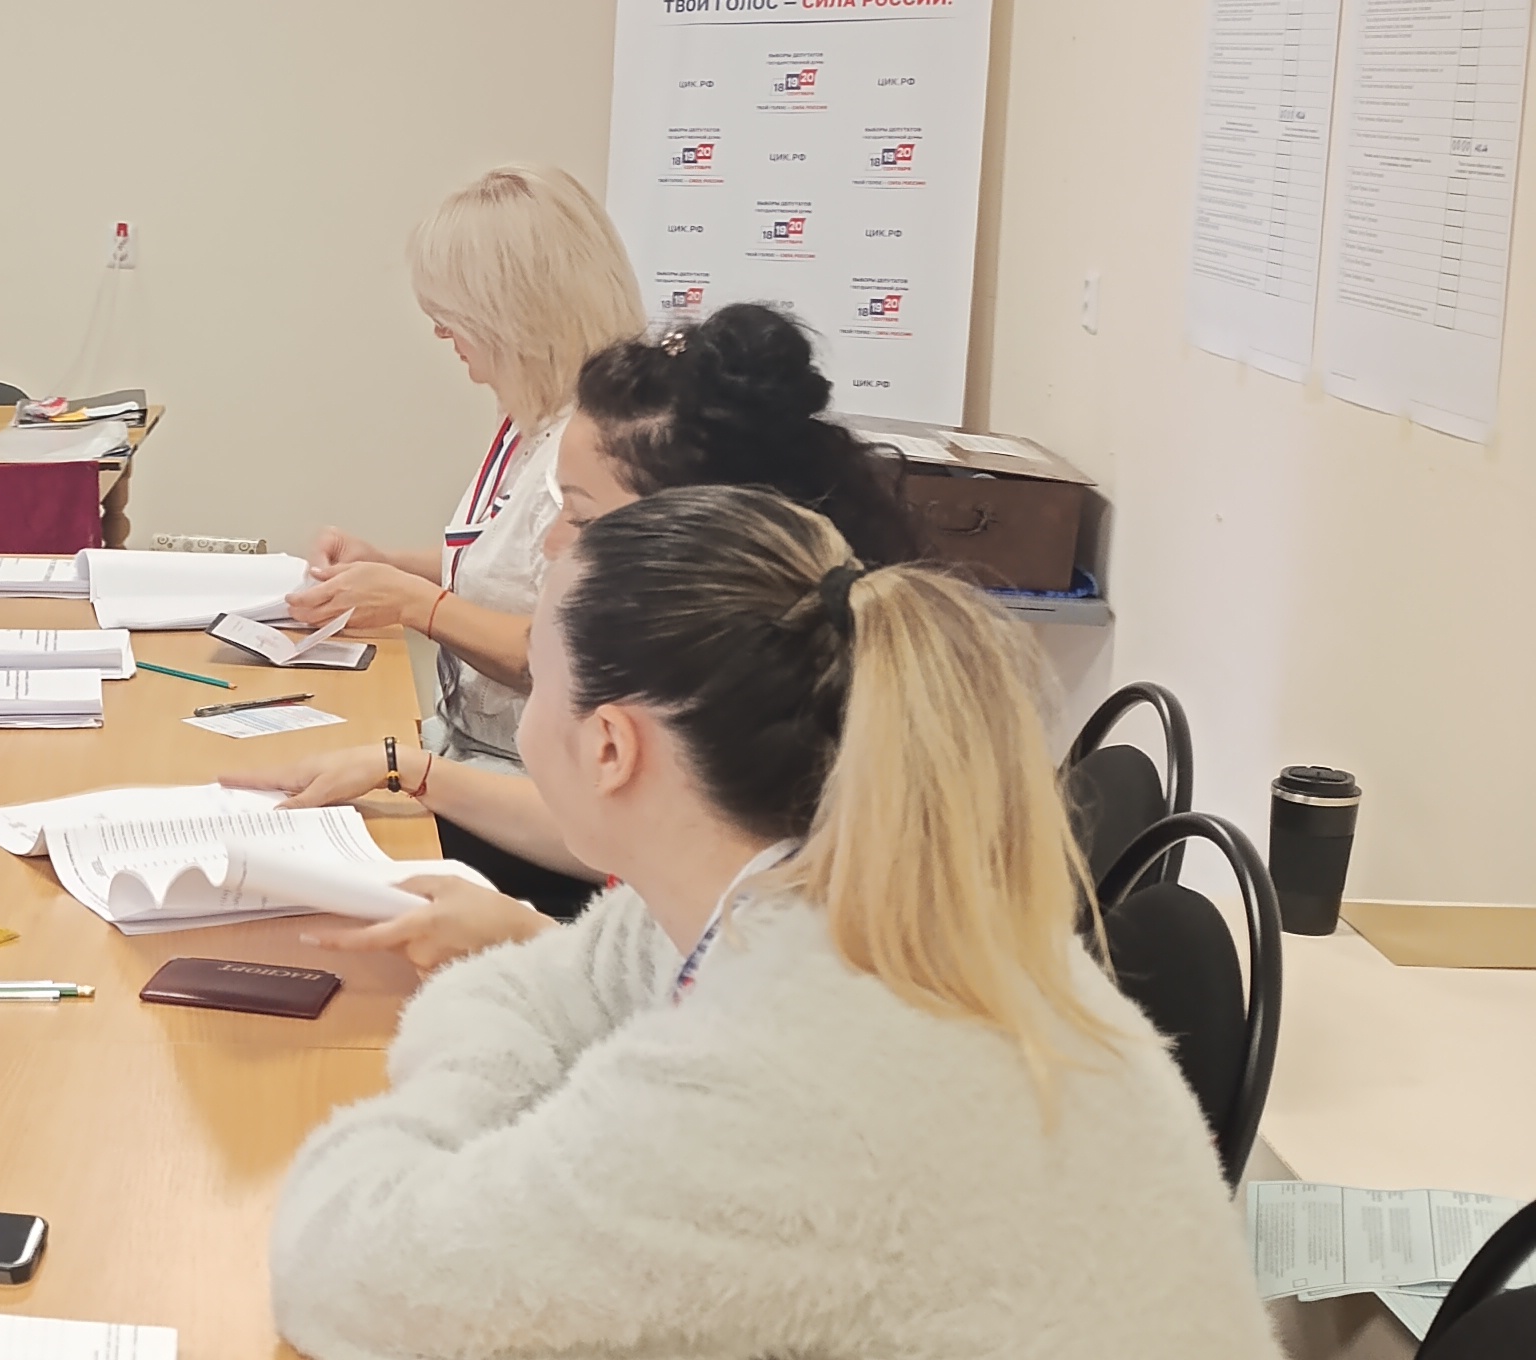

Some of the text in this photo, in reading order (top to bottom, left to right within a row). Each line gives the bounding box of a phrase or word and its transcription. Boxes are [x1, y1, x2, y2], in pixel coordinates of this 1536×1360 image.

[774, 72, 814, 92] 18 19 20
[672, 147, 712, 166] 18 19 20
[870, 147, 912, 167] 18 19 20
[762, 221, 803, 240] 18 19 20
[858, 298, 899, 317] 18 19 20
[217, 964, 323, 981] ПАСПОРТ
